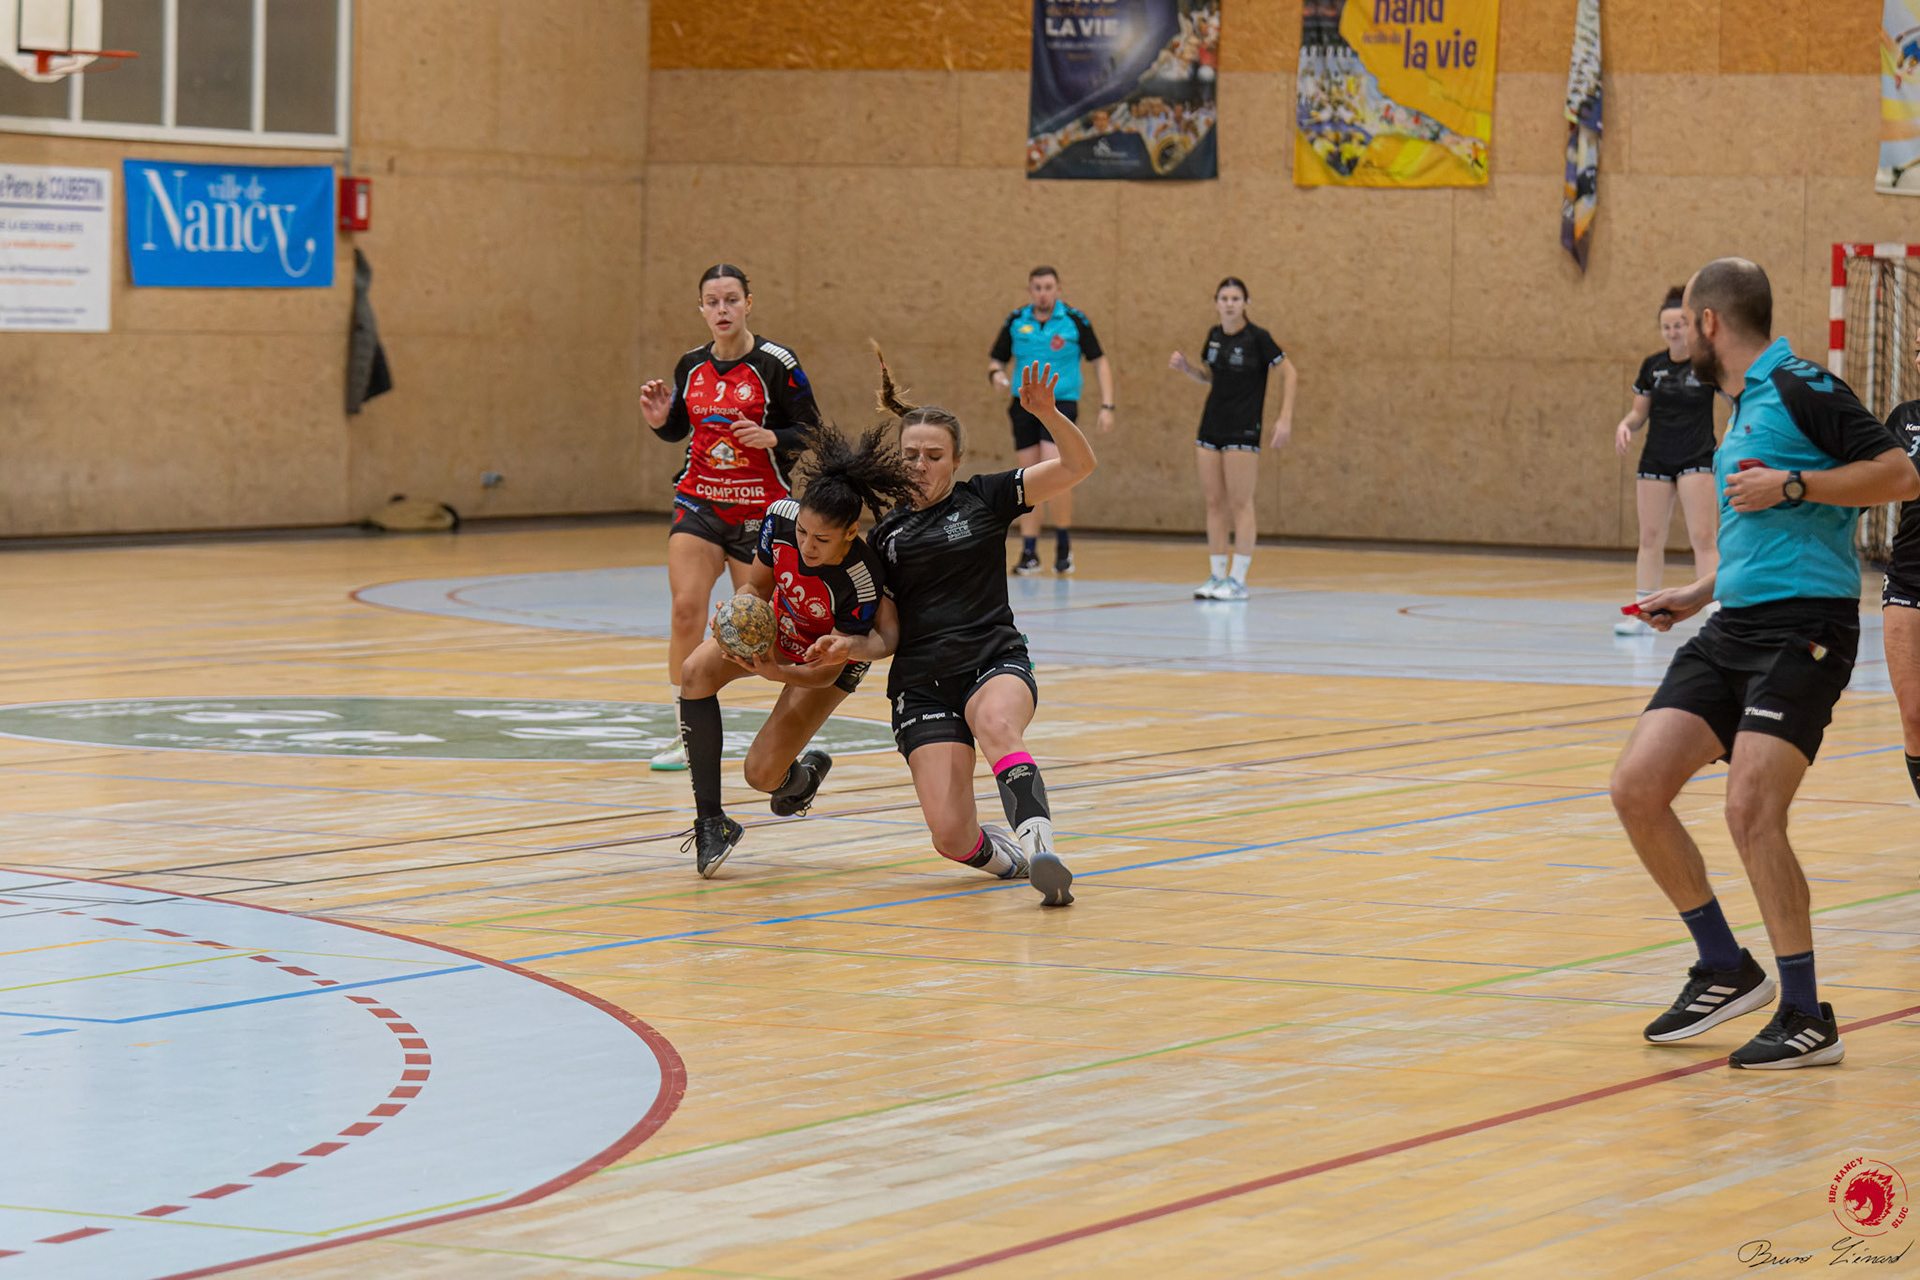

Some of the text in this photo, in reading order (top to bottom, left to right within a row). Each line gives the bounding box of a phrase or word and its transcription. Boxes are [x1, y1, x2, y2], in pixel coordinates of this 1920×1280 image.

[1045, 17, 1119, 37] LA VIE
[1403, 28, 1477, 69] la vie
[142, 168, 316, 278] Nancy
[692, 405, 708, 416] Guy
[696, 484, 766, 498] COMPTOIR
[777, 571, 806, 610] 22
[922, 712, 946, 721] Kempa
